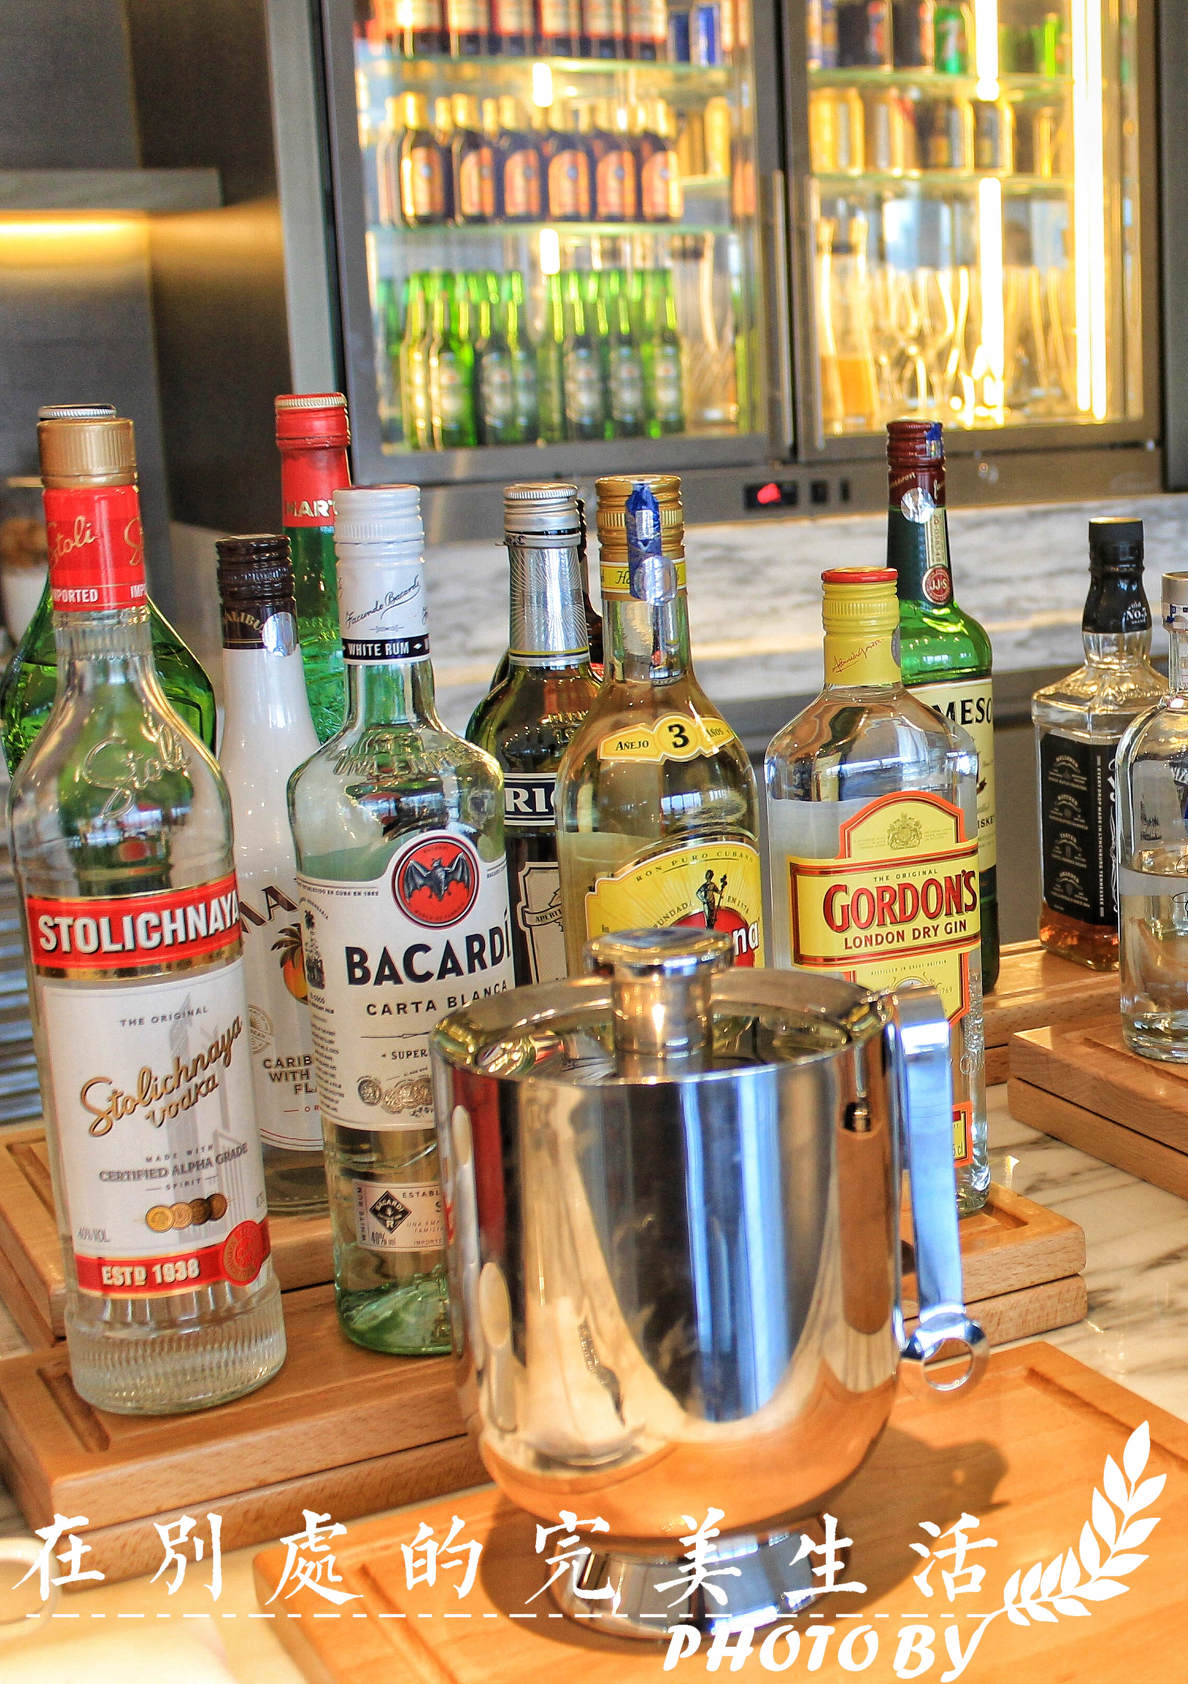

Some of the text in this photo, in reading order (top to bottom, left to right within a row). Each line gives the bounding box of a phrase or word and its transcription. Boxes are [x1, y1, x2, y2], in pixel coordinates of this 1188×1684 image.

[348, 641, 410, 657] WHITE RUM
[667, 723, 690, 749] 3
[635, 864, 664, 883] RON
[671, 852, 709, 867] PURO
[873, 869, 939, 883] THE ORIGINAL
[823, 869, 978, 933] GORDON'S
[37, 889, 240, 954] STOLICHNAYA
[844, 919, 968, 950] LONDON DRY GIN
[366, 979, 509, 1017] CARTA BLANCA
[120, 1006, 209, 1028] THE ORIGINAL
[80, 1016, 243, 1138] Stolichnaya
[269, 1071, 310, 1083] WITH
[145, 1073, 220, 1129] vodka
[99, 1142, 249, 1183] CERTIFIED ALPHA GRADE
[165, 1178, 201, 1191] SPIRIT
